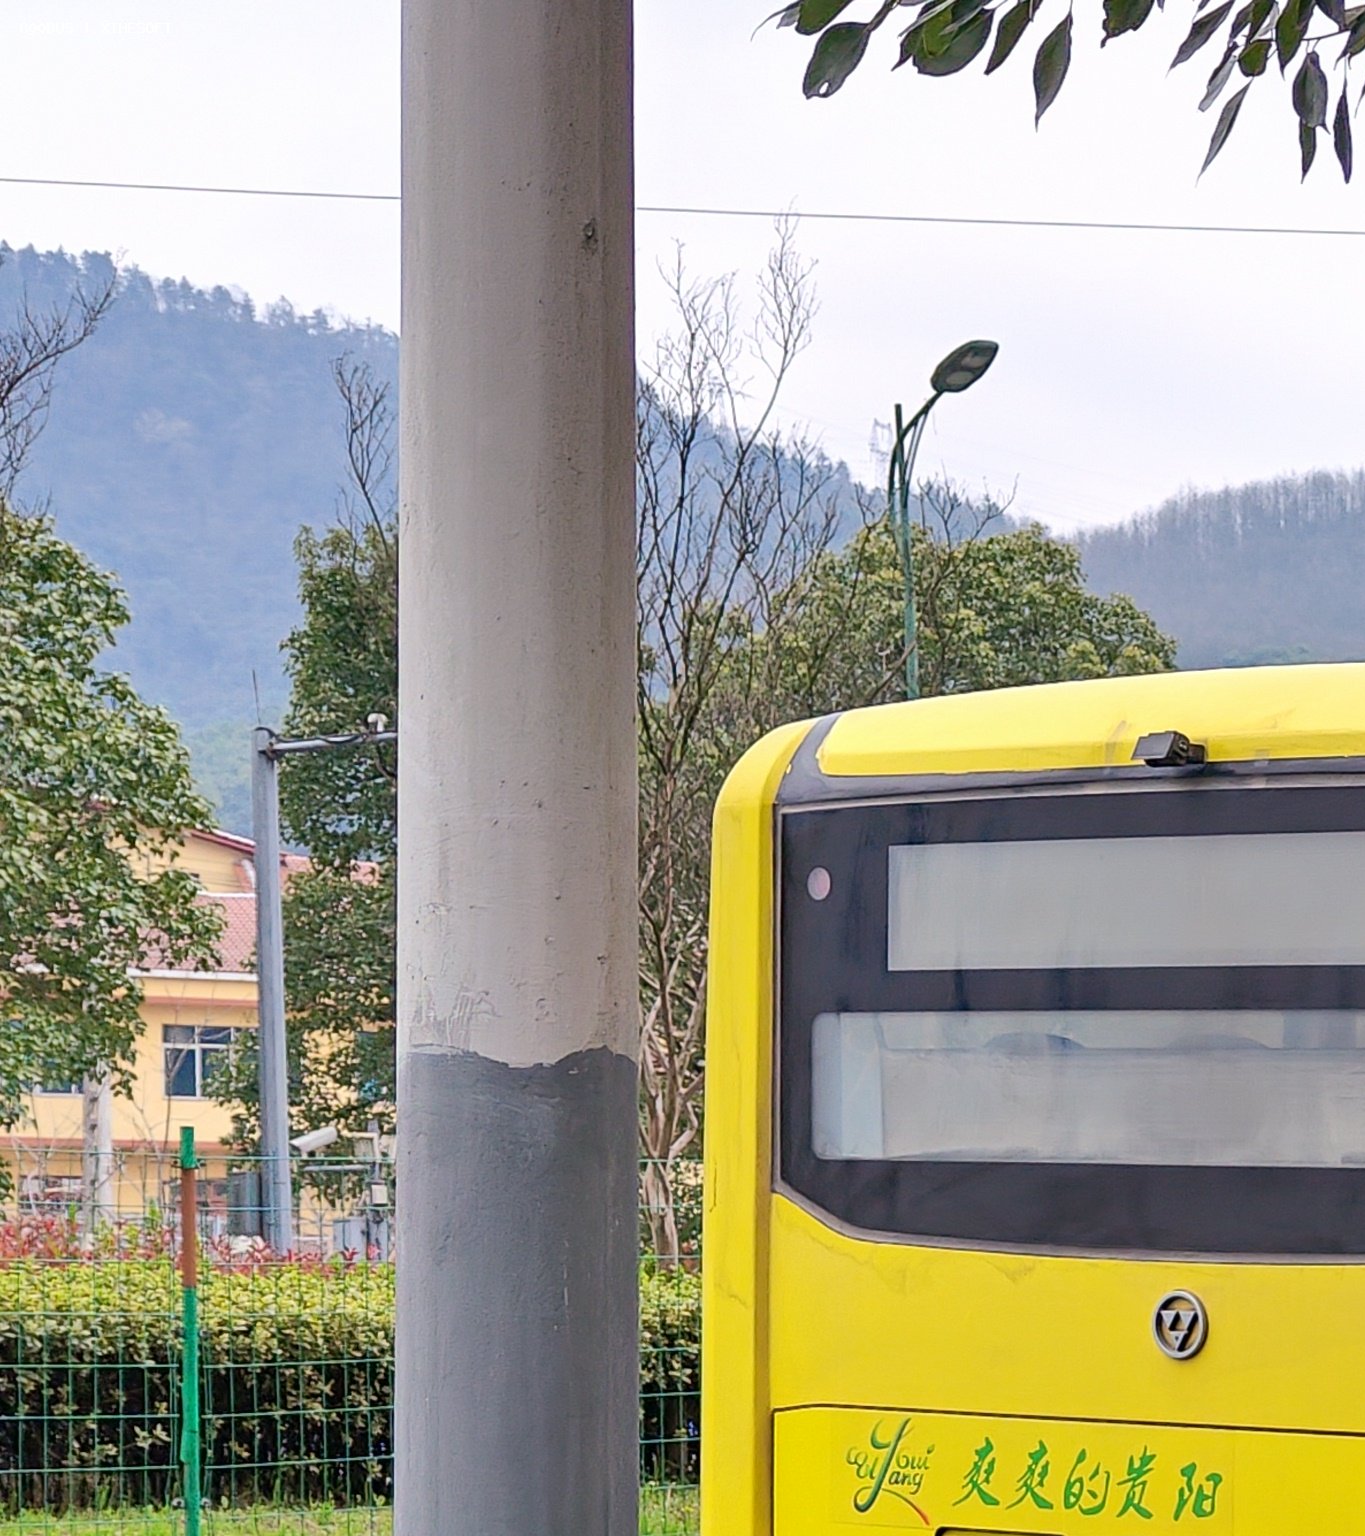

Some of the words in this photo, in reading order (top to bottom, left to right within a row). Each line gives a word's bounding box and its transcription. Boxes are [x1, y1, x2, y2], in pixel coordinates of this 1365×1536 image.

[951, 1436, 1224, 1522] 爽爽的贵阳
